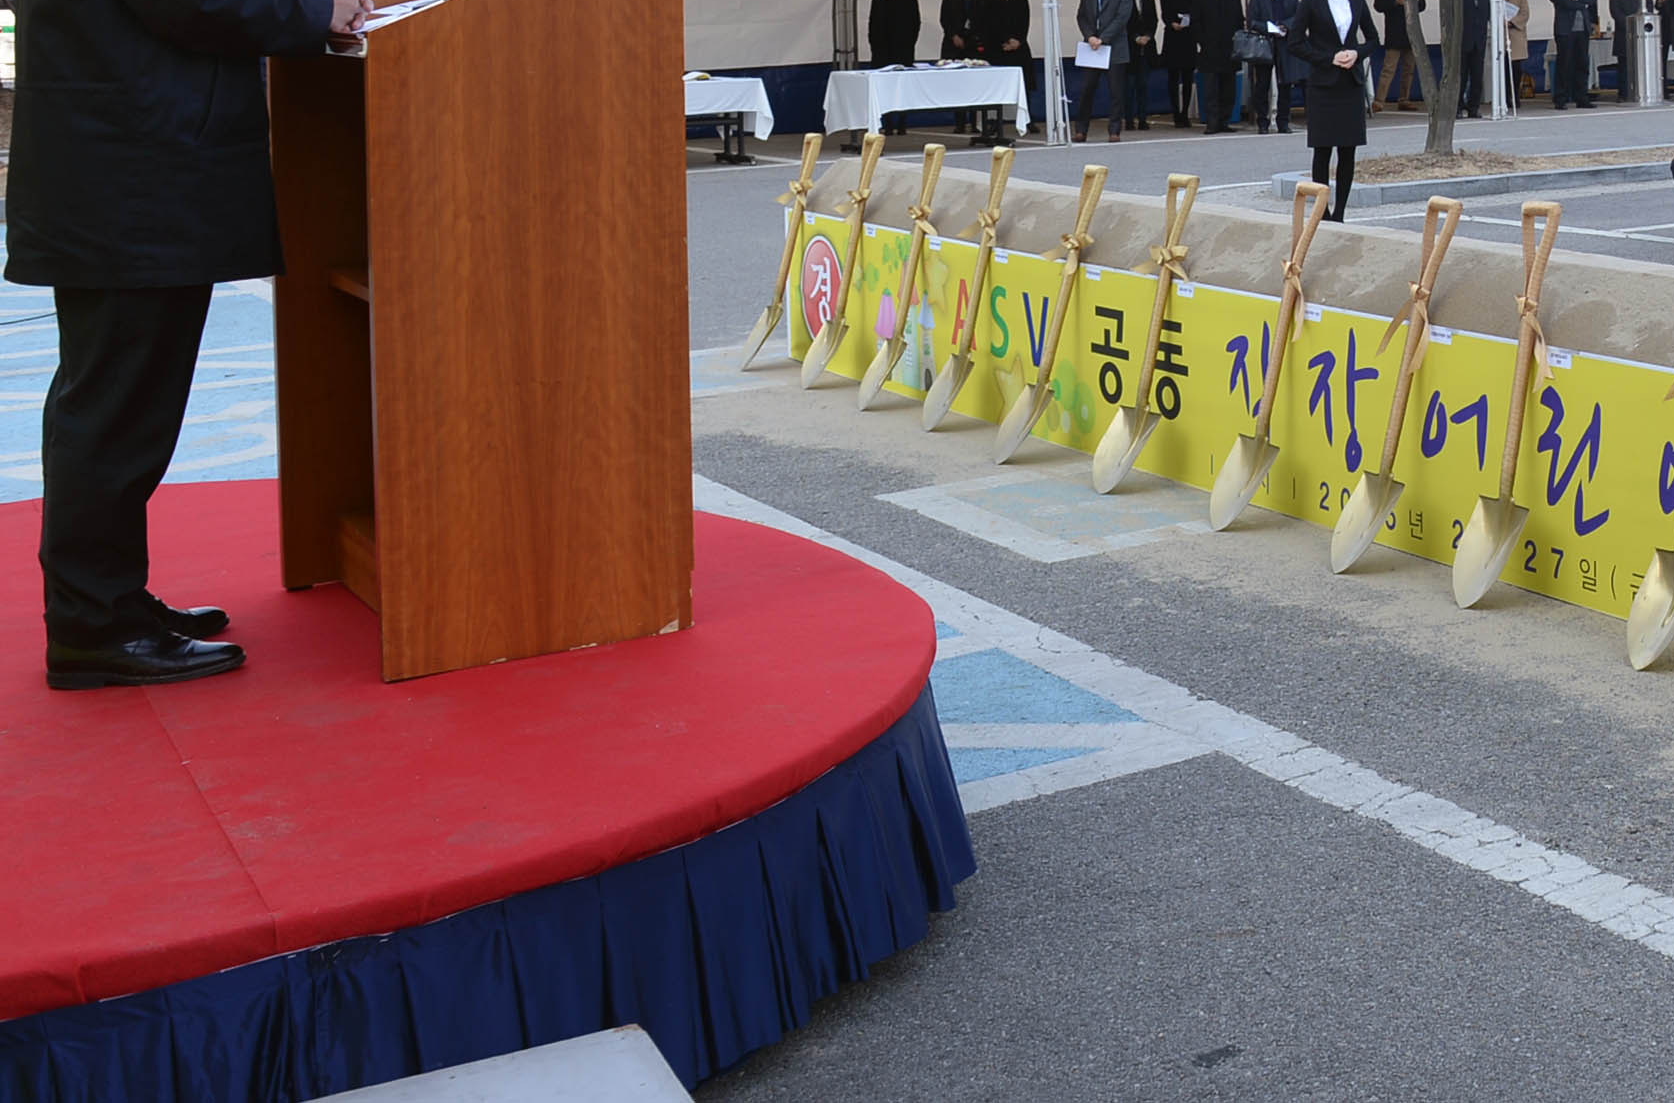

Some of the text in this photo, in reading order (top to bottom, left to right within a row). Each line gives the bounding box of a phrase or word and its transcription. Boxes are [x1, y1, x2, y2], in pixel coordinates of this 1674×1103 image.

[809, 256, 832, 322] 경
[951, 278, 1050, 368] ASV
[1090, 305, 1190, 421] 공동
